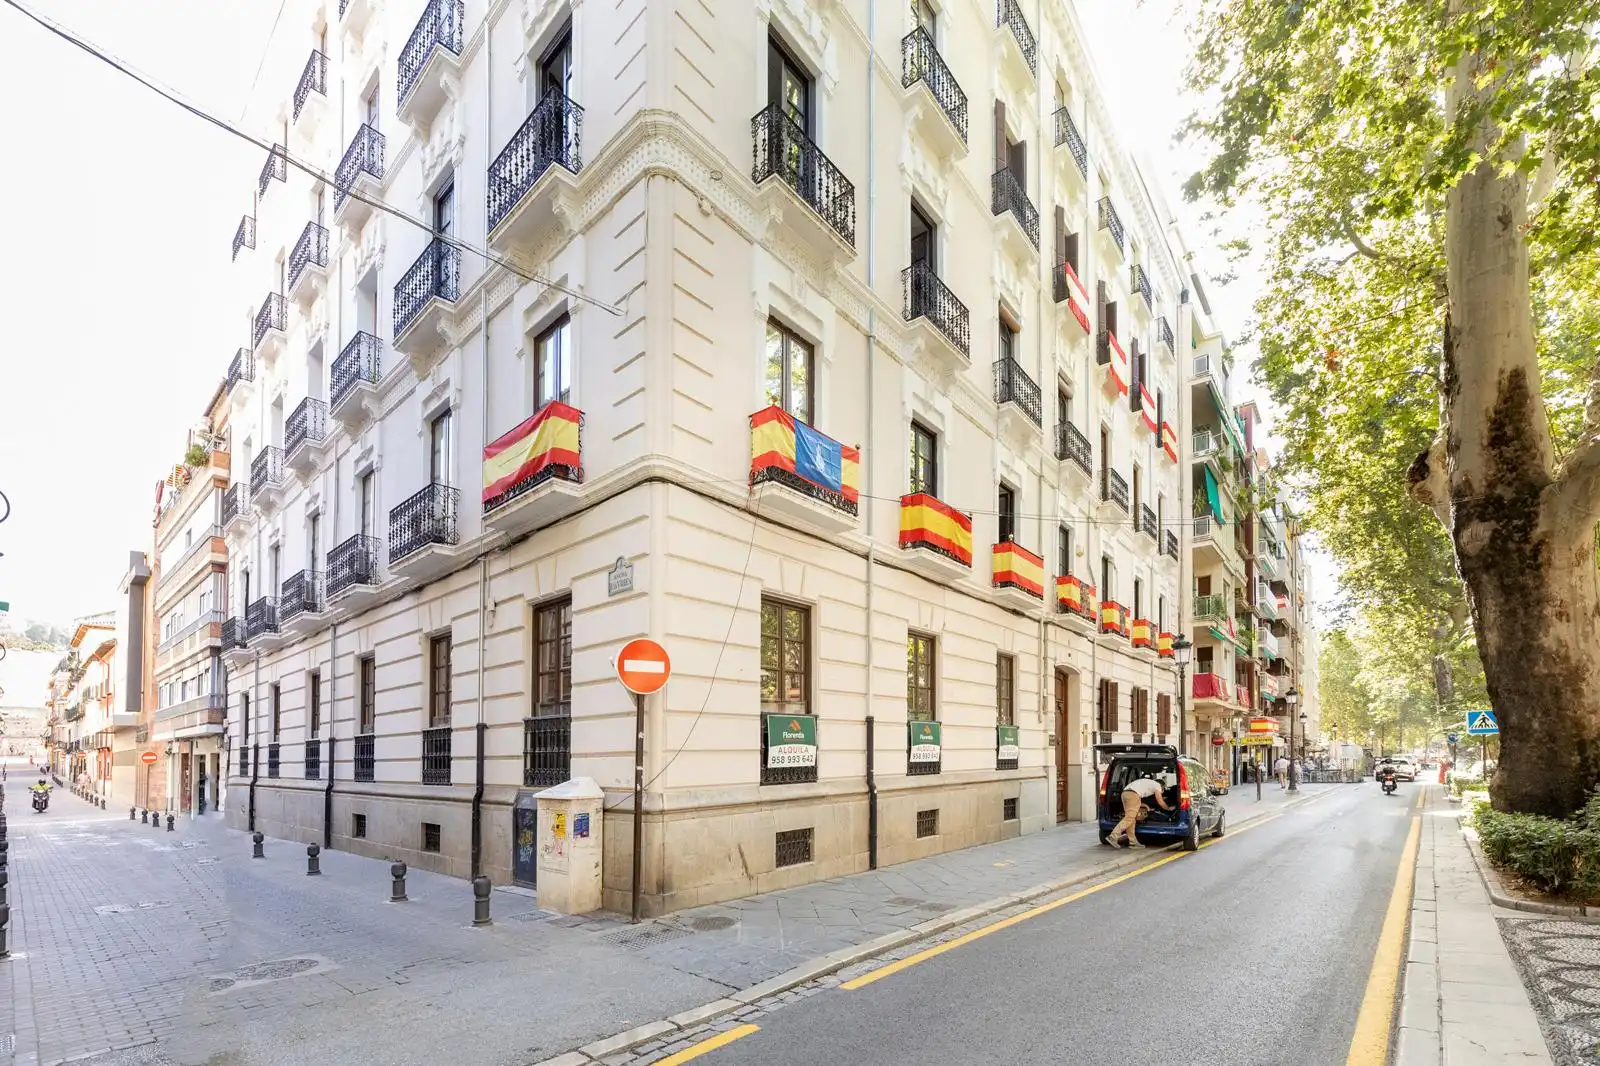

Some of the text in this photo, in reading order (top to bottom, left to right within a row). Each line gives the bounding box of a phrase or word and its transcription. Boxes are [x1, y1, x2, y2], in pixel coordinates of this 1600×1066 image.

[778, 746, 809, 754] ALQUILA
[771, 755, 785, 764] 958
[787, 755, 801, 763] 993
